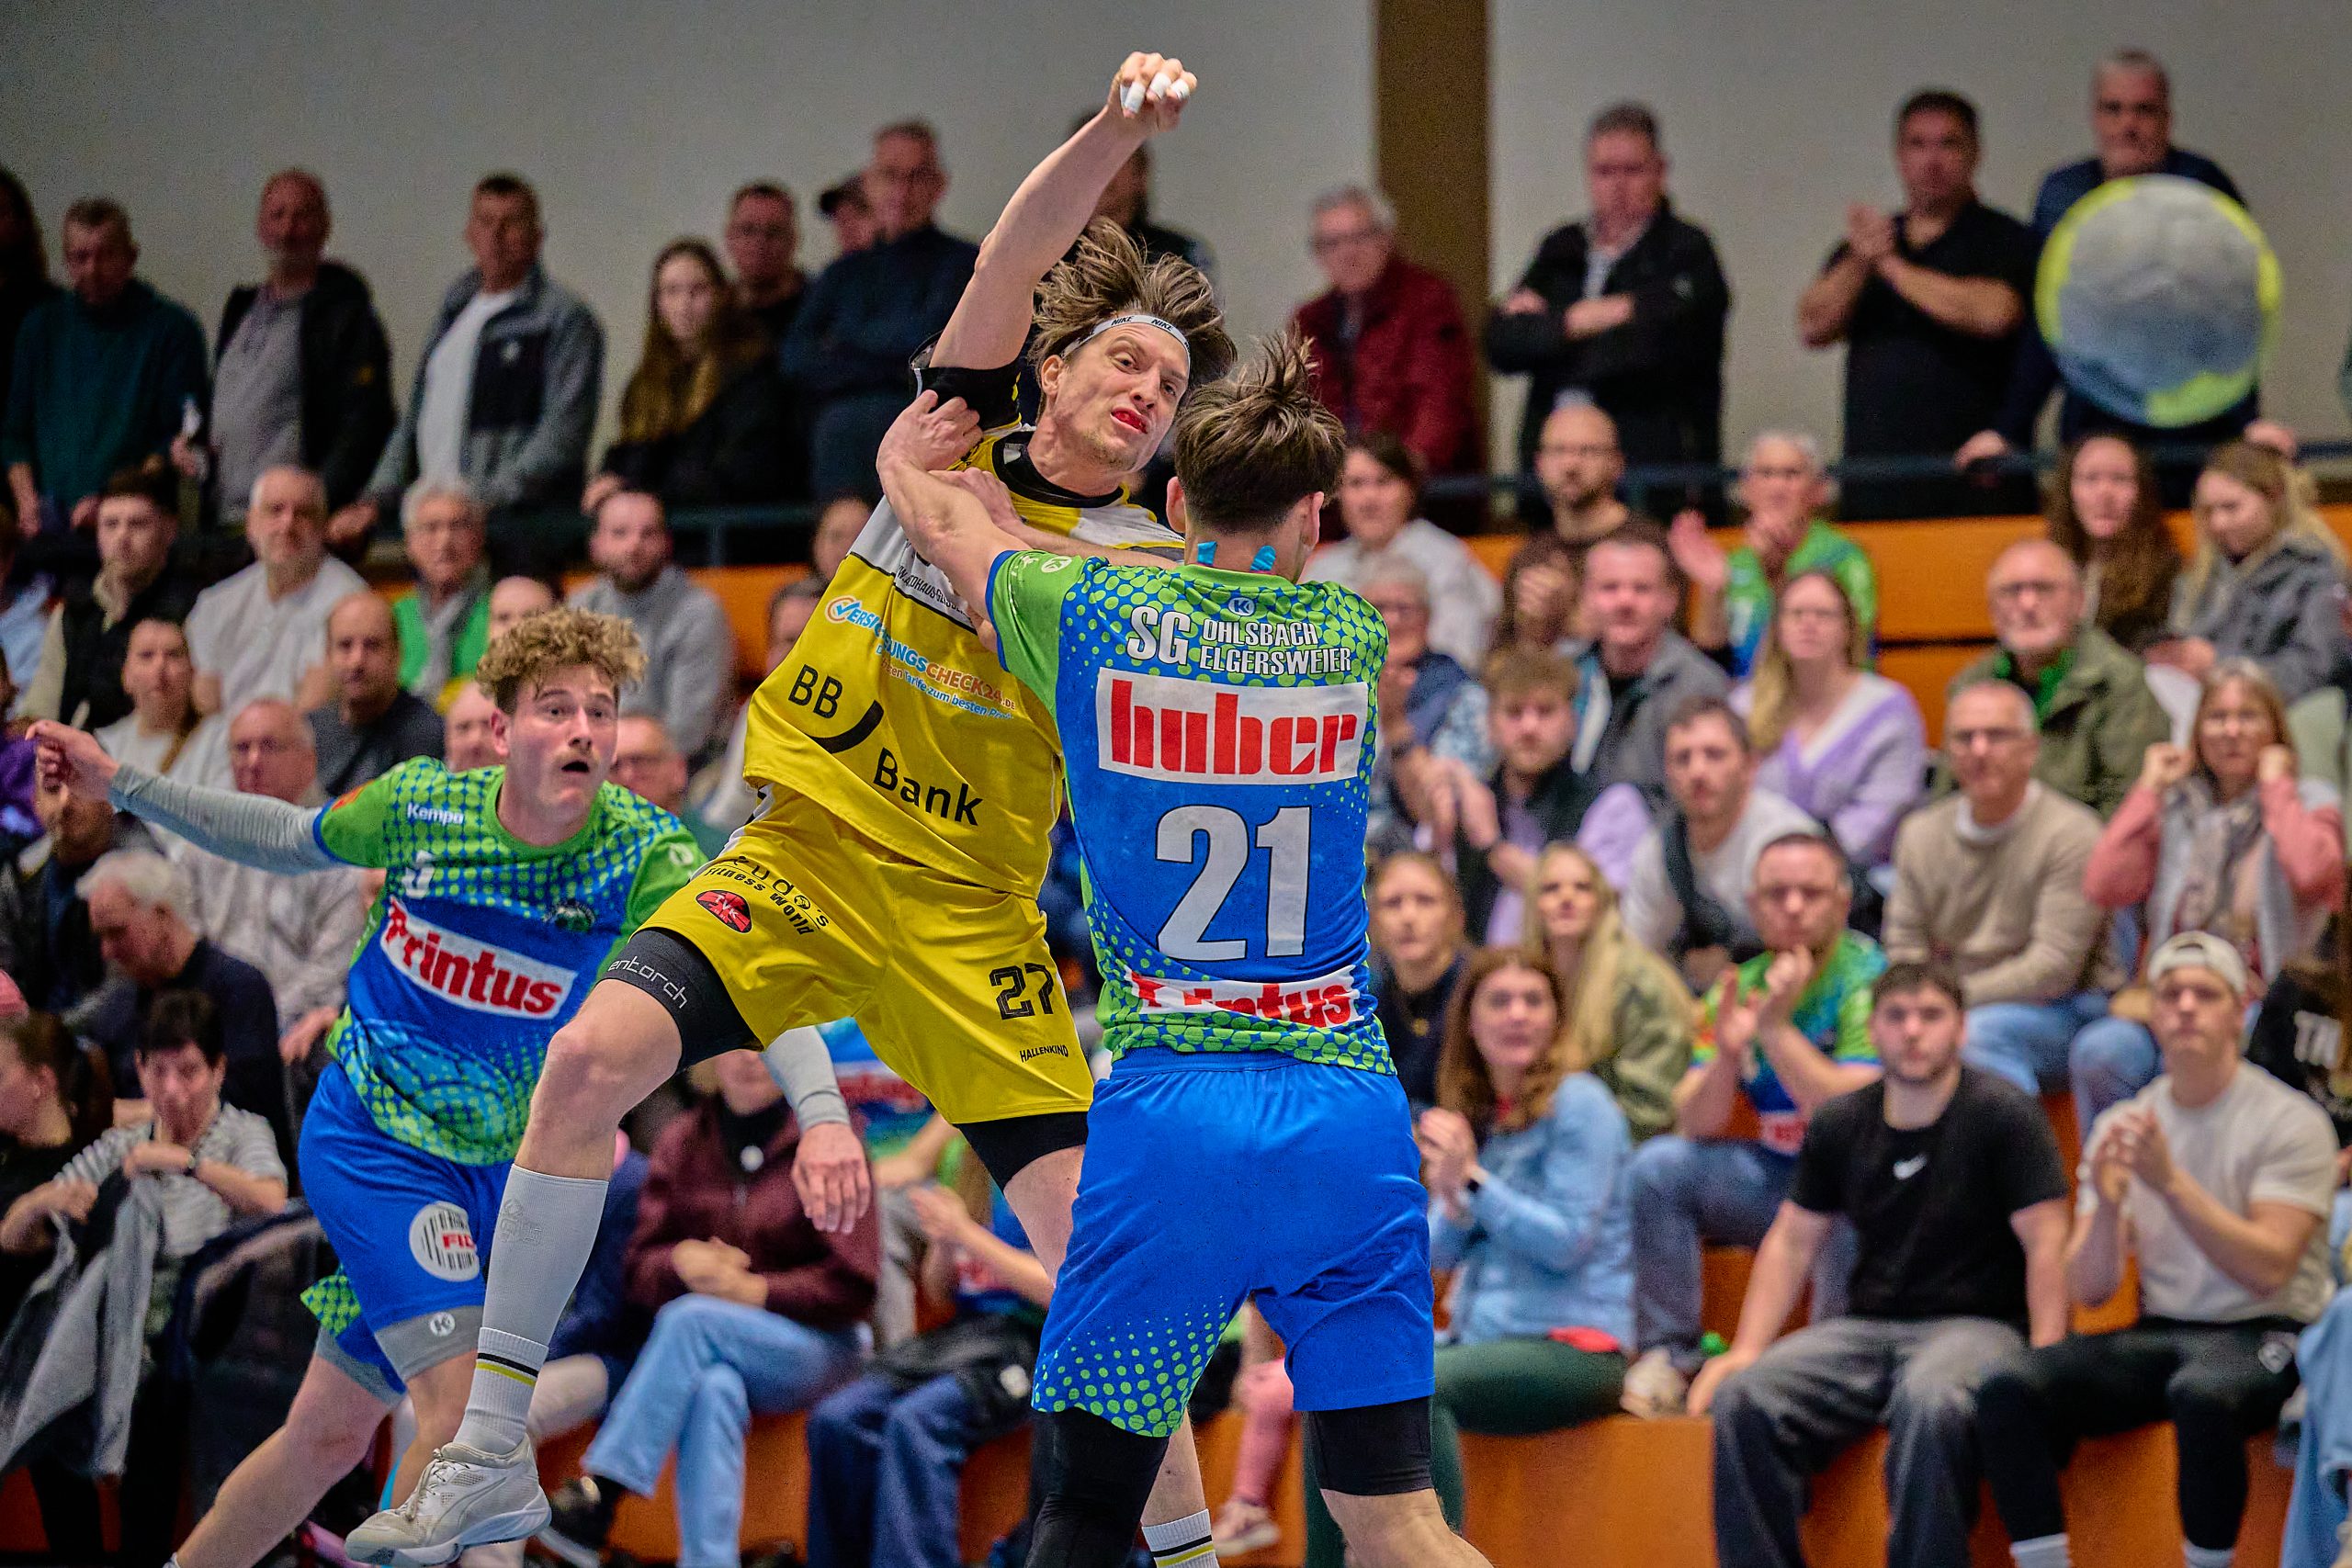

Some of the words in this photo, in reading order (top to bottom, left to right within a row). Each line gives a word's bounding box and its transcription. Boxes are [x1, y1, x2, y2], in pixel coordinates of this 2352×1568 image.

[1111, 315, 1134, 326] NIKE
[1150, 318, 1173, 332] NIKE
[1126, 605, 1192, 666] SG
[1202, 617, 1319, 648] OHLSBACH
[1198, 646, 1353, 676] ELGERSWEIER
[787, 663, 843, 719] BB
[927, 686, 950, 704] zum
[951, 694, 988, 716] besten
[1111, 678, 1358, 776] huber
[407, 802, 464, 827] Kempa
[872, 747, 984, 827] Bank
[1155, 803, 1313, 963] 21
[989, 962, 1055, 1021] 27
[1019, 1043, 1069, 1063] HALLENKIND
